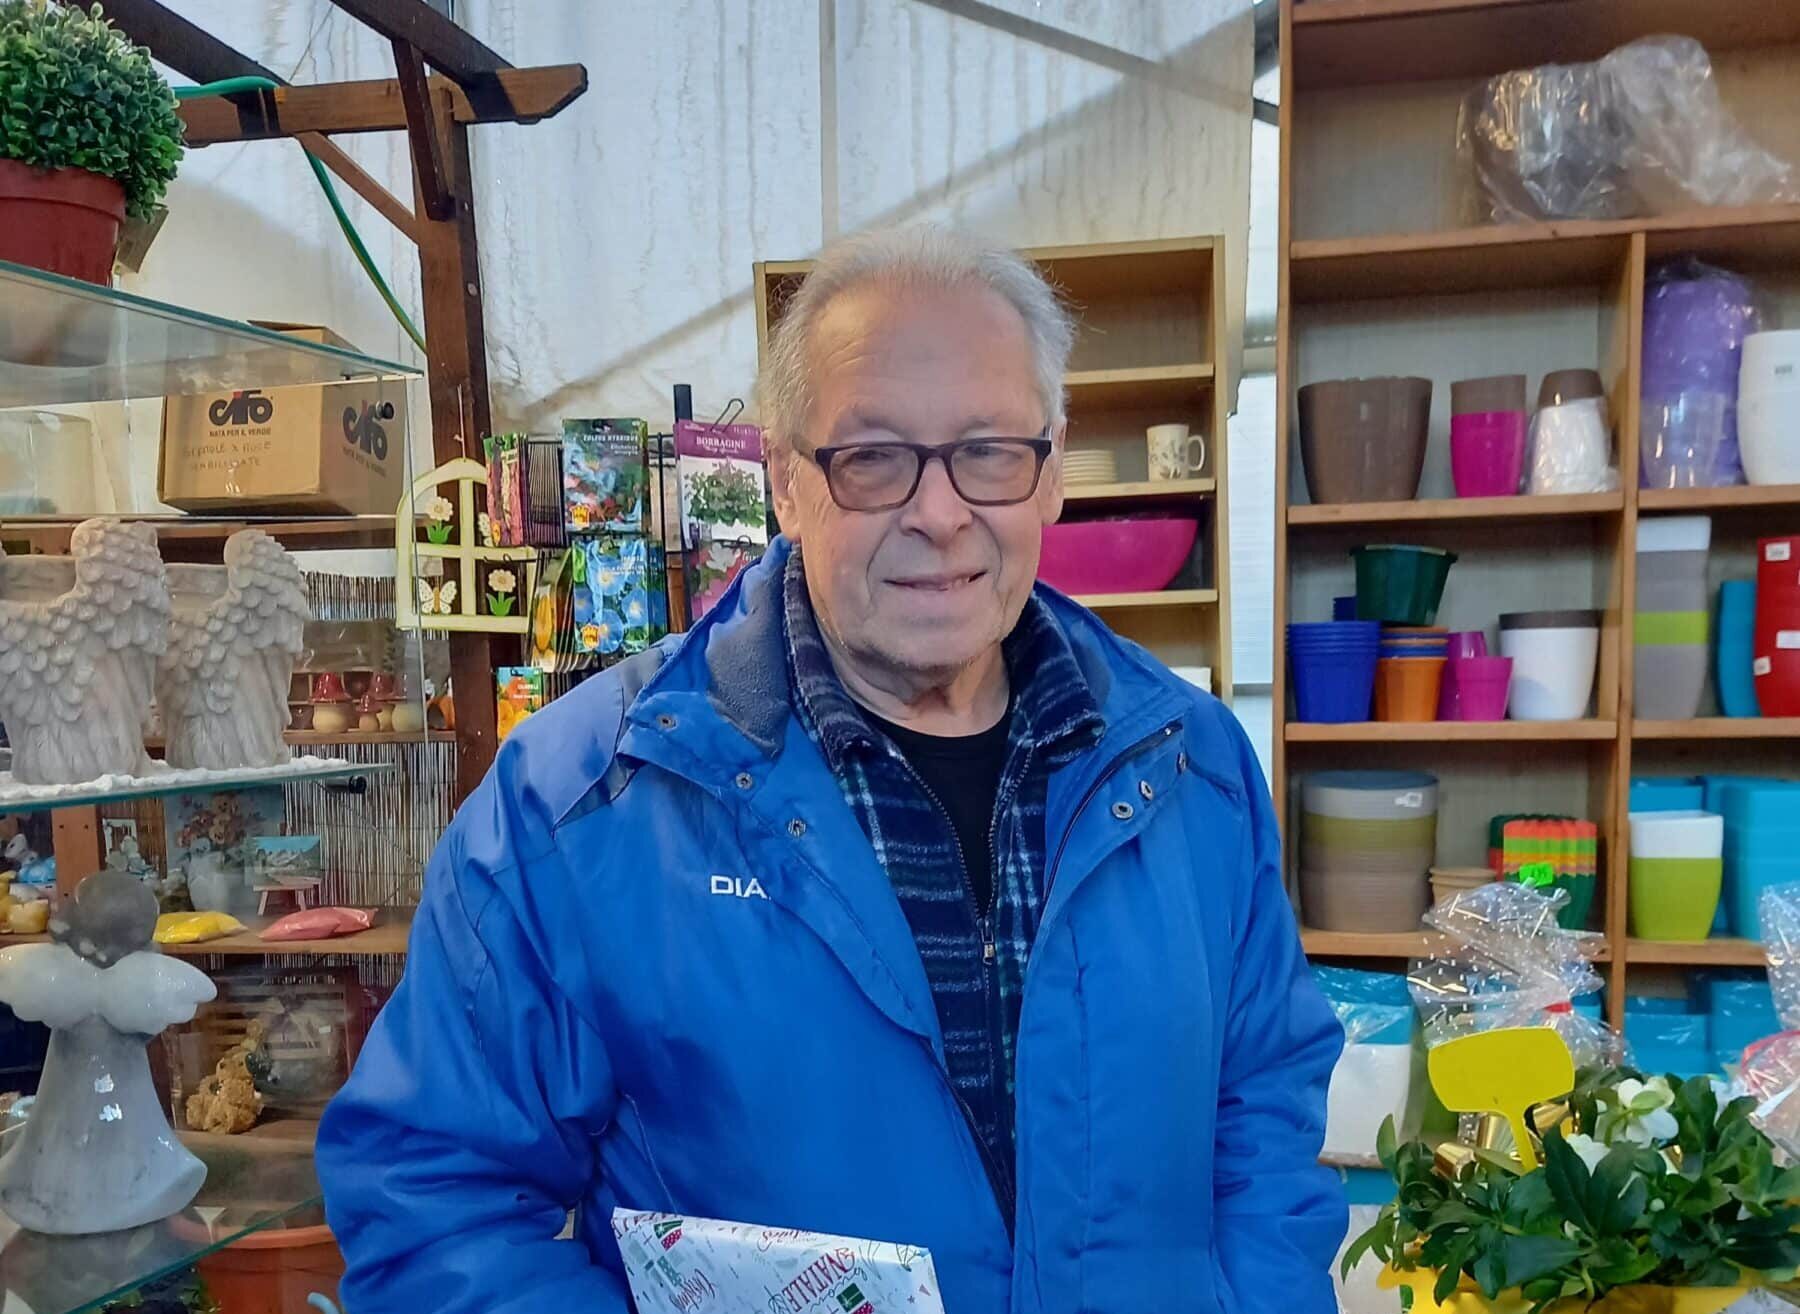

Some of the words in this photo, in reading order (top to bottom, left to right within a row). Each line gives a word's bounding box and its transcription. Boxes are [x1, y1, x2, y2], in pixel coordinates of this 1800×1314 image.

[696, 436, 746, 449] BORRAGINE
[711, 875, 768, 899] DIA
[781, 1248, 855, 1313] NATALE
